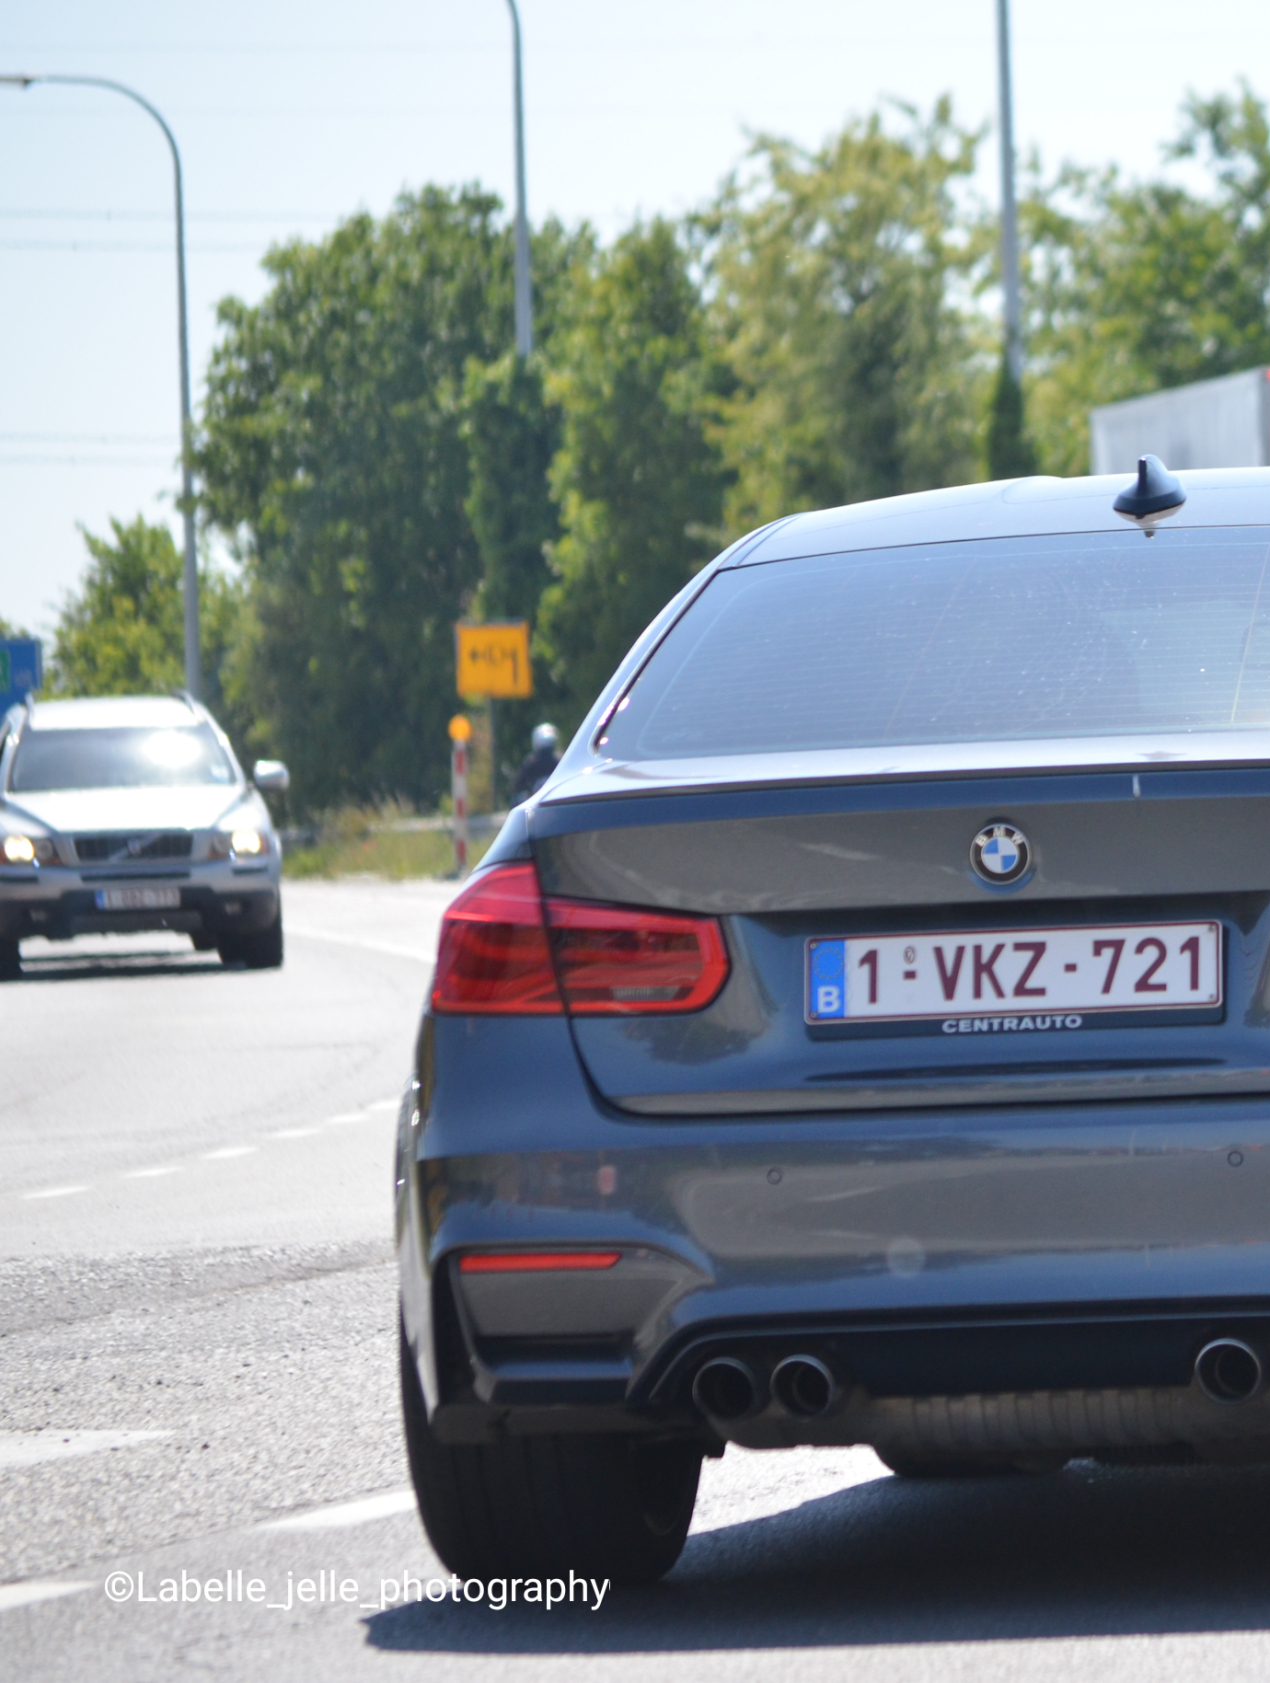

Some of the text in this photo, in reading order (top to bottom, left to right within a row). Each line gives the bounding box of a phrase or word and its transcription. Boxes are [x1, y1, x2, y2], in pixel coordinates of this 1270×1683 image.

[975, 825, 1025, 847] BMW
[858, 936, 1200, 1004] 1-VKZ-721
[817, 985, 840, 1013] B
[941, 1014, 1083, 1034] CENTRAUTO
